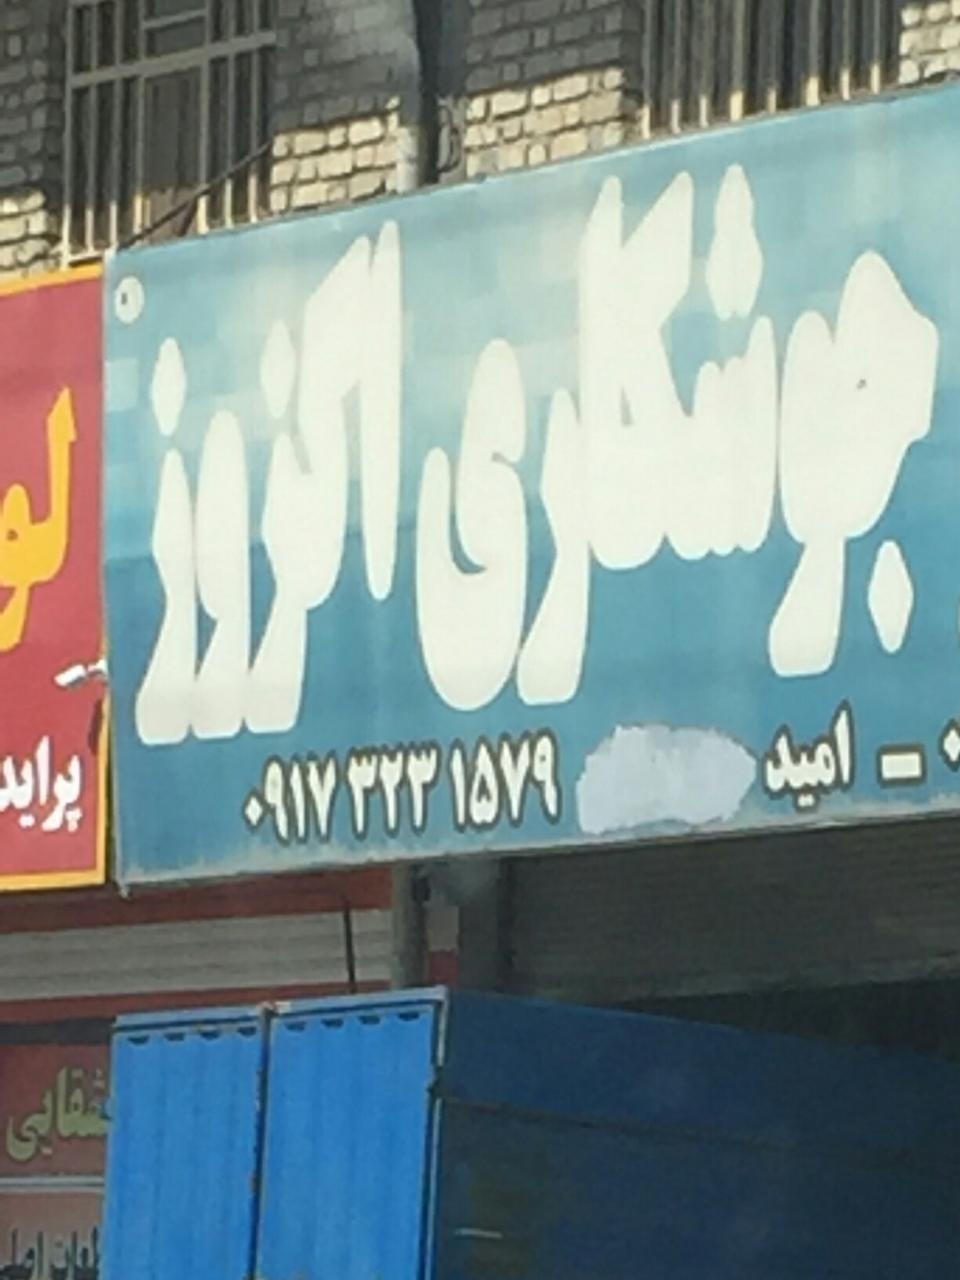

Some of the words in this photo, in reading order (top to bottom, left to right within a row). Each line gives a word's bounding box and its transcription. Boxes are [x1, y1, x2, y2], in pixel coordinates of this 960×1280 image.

[415, 163, 940, 711] جوشکاری
[243, 752, 338, 843] ۰۹۱۷
[450, 728, 562, 833] ۱۵۷۹
[762, 700, 855, 812] امید
